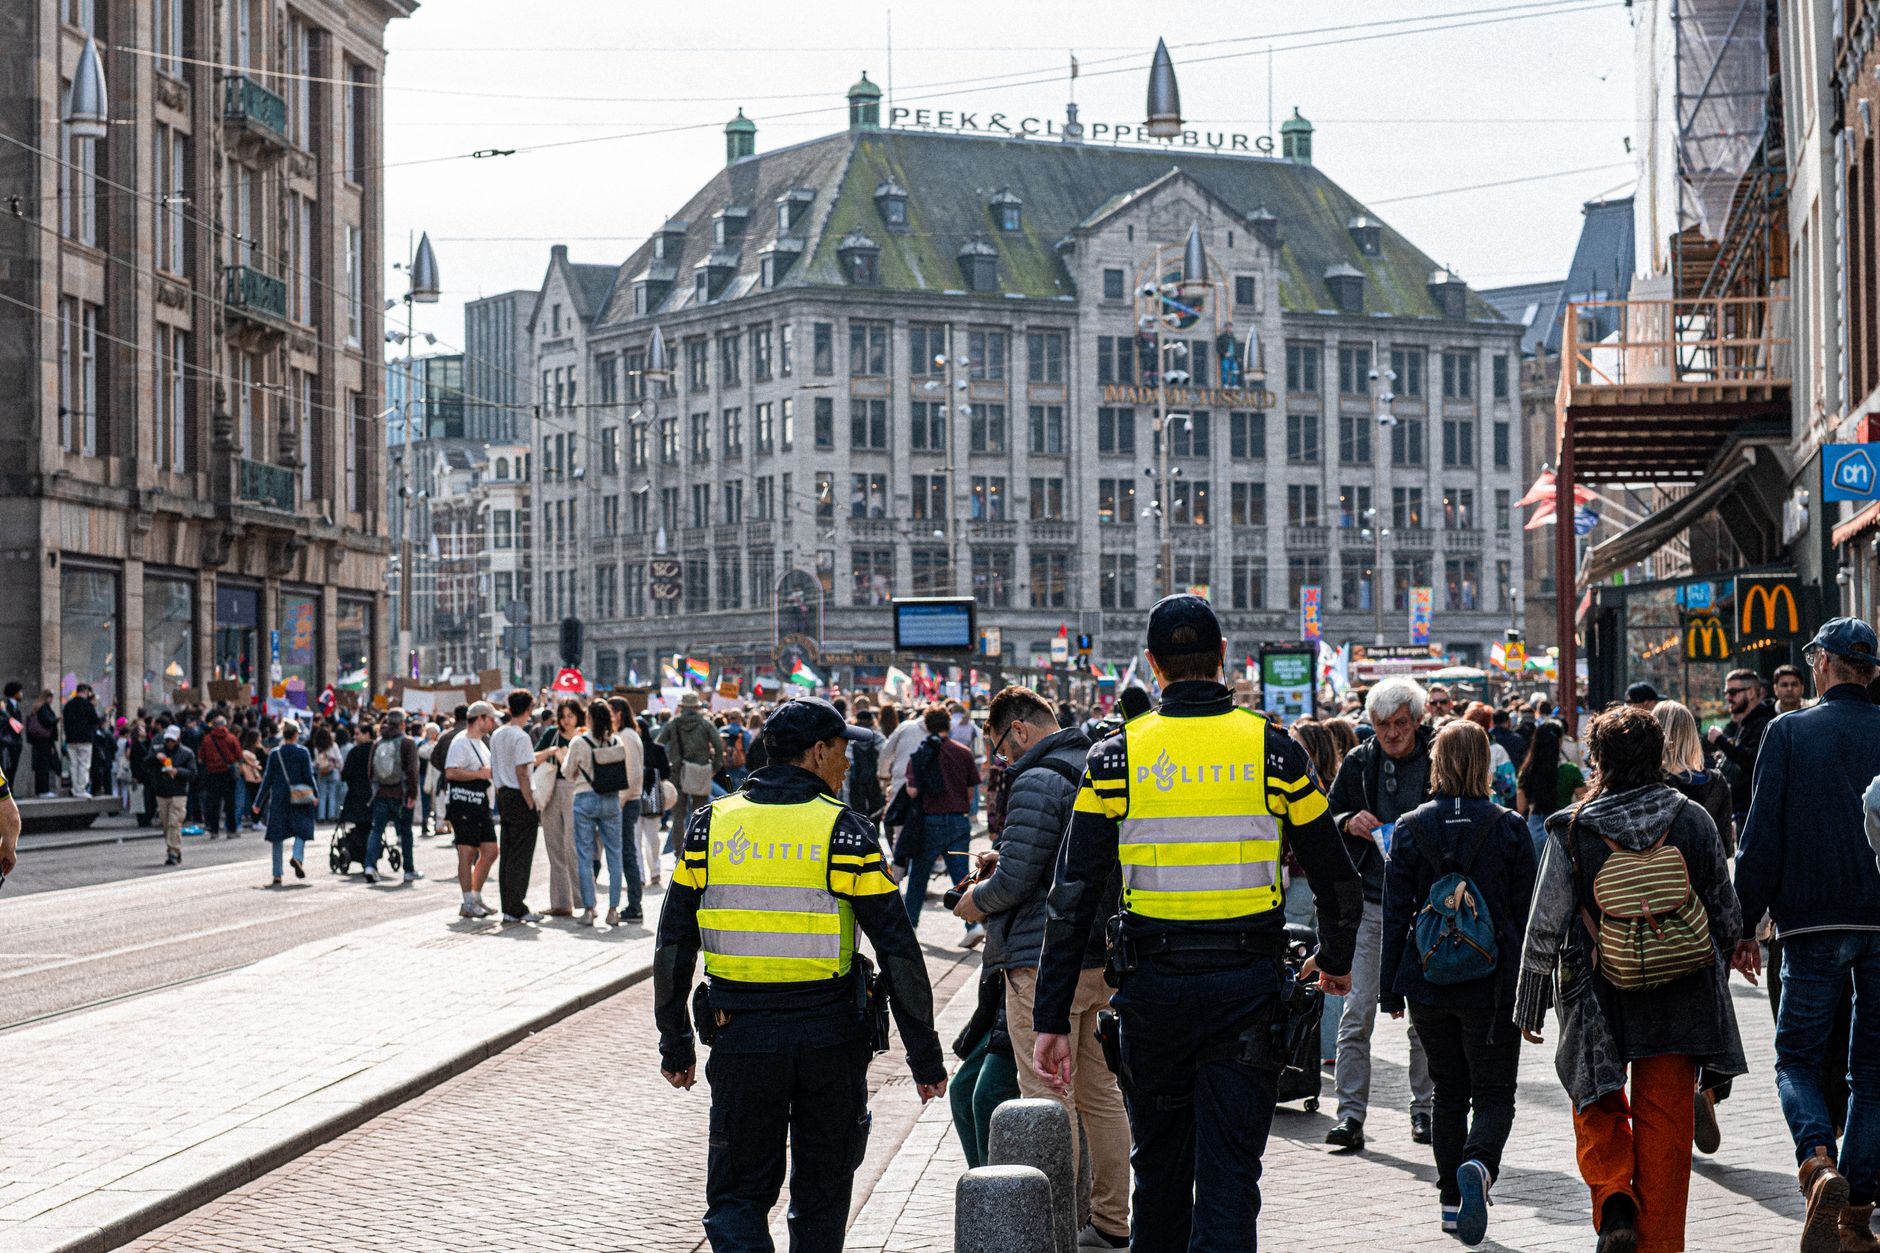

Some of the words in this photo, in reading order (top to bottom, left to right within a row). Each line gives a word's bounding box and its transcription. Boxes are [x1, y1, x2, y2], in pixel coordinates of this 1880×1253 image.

[891, 107, 979, 128] PEEK
[987, 113, 1011, 132] &
[1020, 116, 1276, 153] CLOPPEBURG
[1136, 755, 1256, 792] POLITIE
[452, 793, 468, 801] One
[468, 796, 482, 805] Leg
[712, 832, 823, 865] POLITIE
